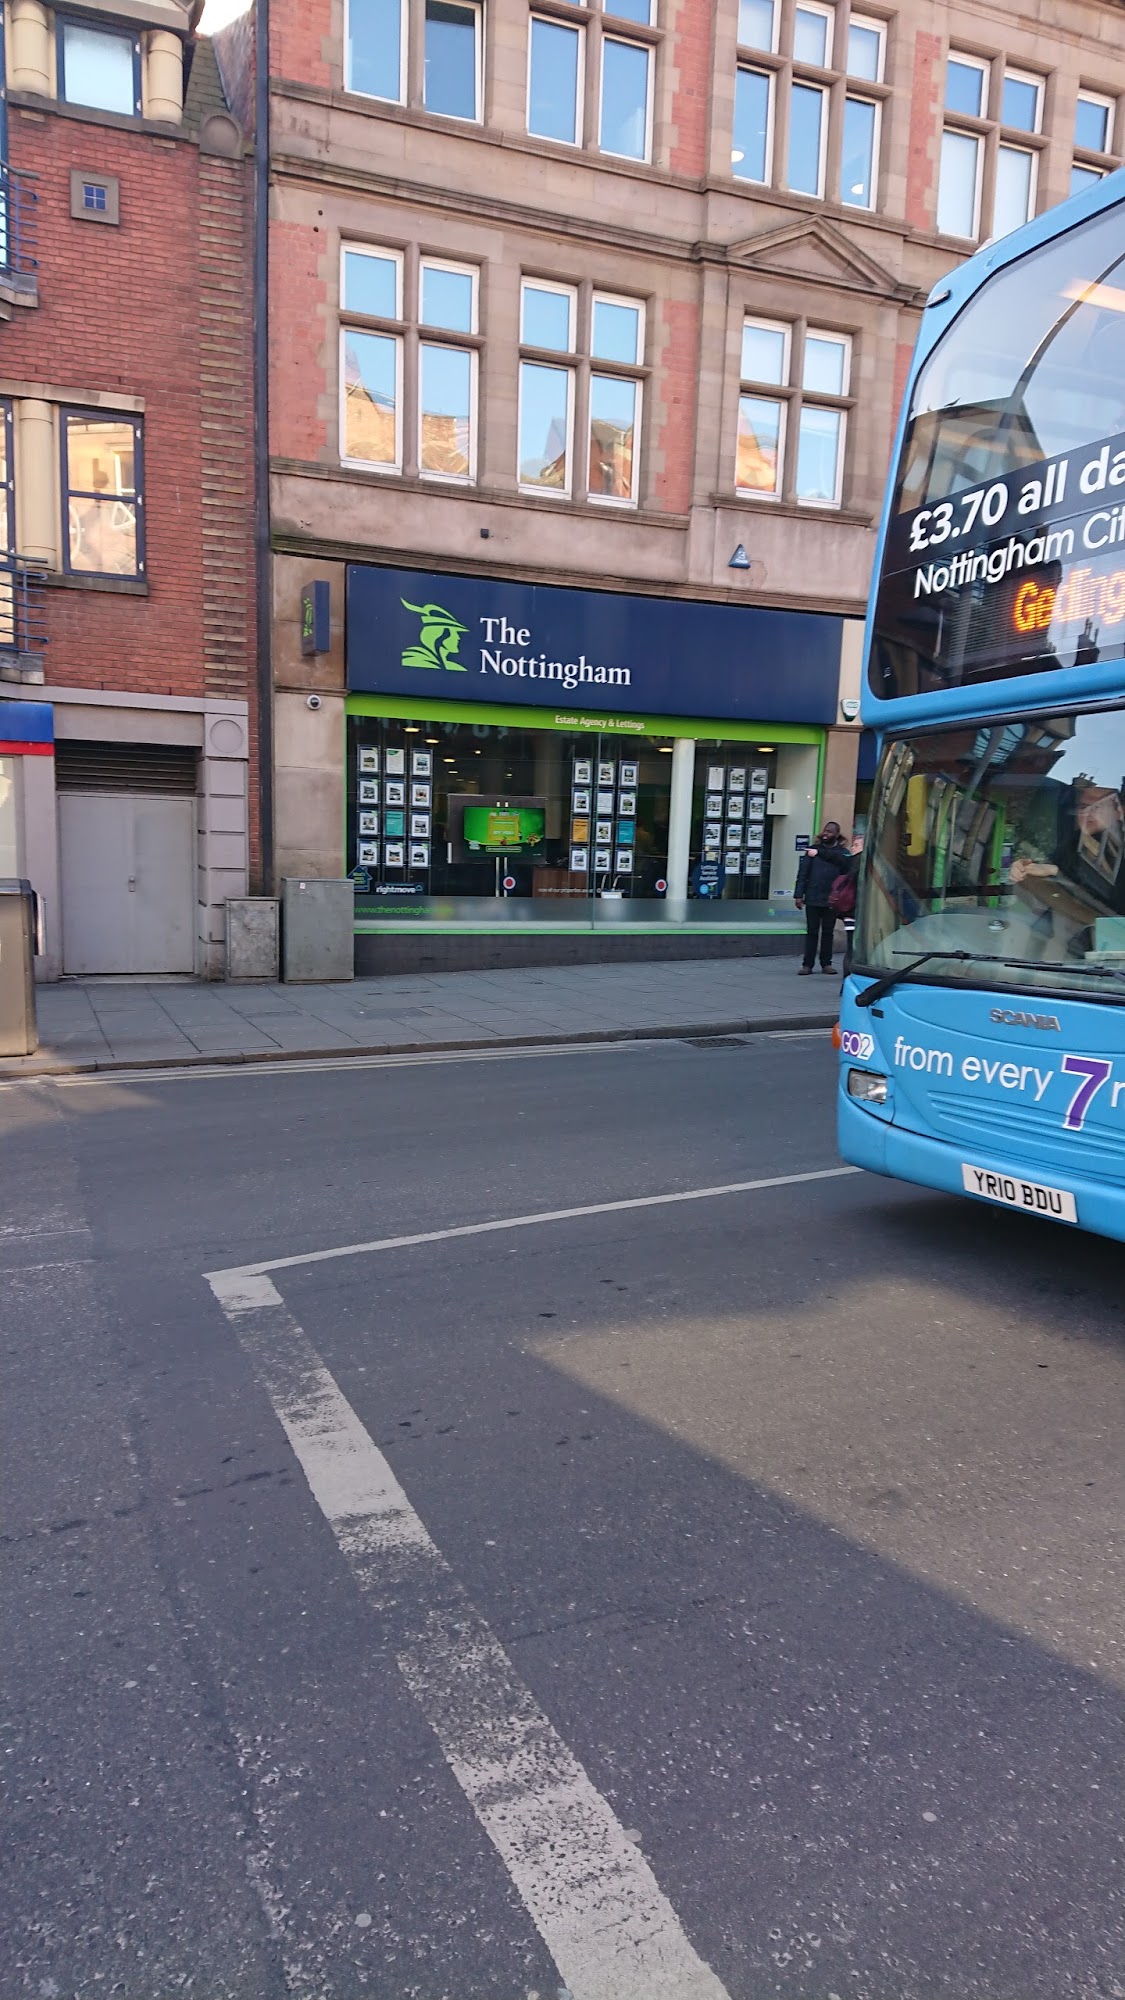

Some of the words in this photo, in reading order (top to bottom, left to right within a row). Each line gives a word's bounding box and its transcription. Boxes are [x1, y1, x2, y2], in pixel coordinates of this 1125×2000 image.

[909, 481, 1008, 552] £3.70
[1017, 460, 1068, 515] all
[913, 529, 1075, 599] Nottingham
[480, 616, 531, 646] The
[479, 649, 632, 689] Nottingham
[554, 715, 579, 725] Estate
[580, 717, 607, 728] Agency
[608, 719, 615, 727] &
[616, 719, 645, 730] Lettings
[375, 886, 416, 895] rightmove
[989, 1008, 1061, 1032] SCANIA
[841, 1031, 873, 1060] GO2
[894, 1036, 953, 1077] from
[961, 1056, 1054, 1101] every
[1061, 1054, 1113, 1131] 7
[973, 1170, 1015, 1201] YR10
[1021, 1187, 1062, 1214] BDU
